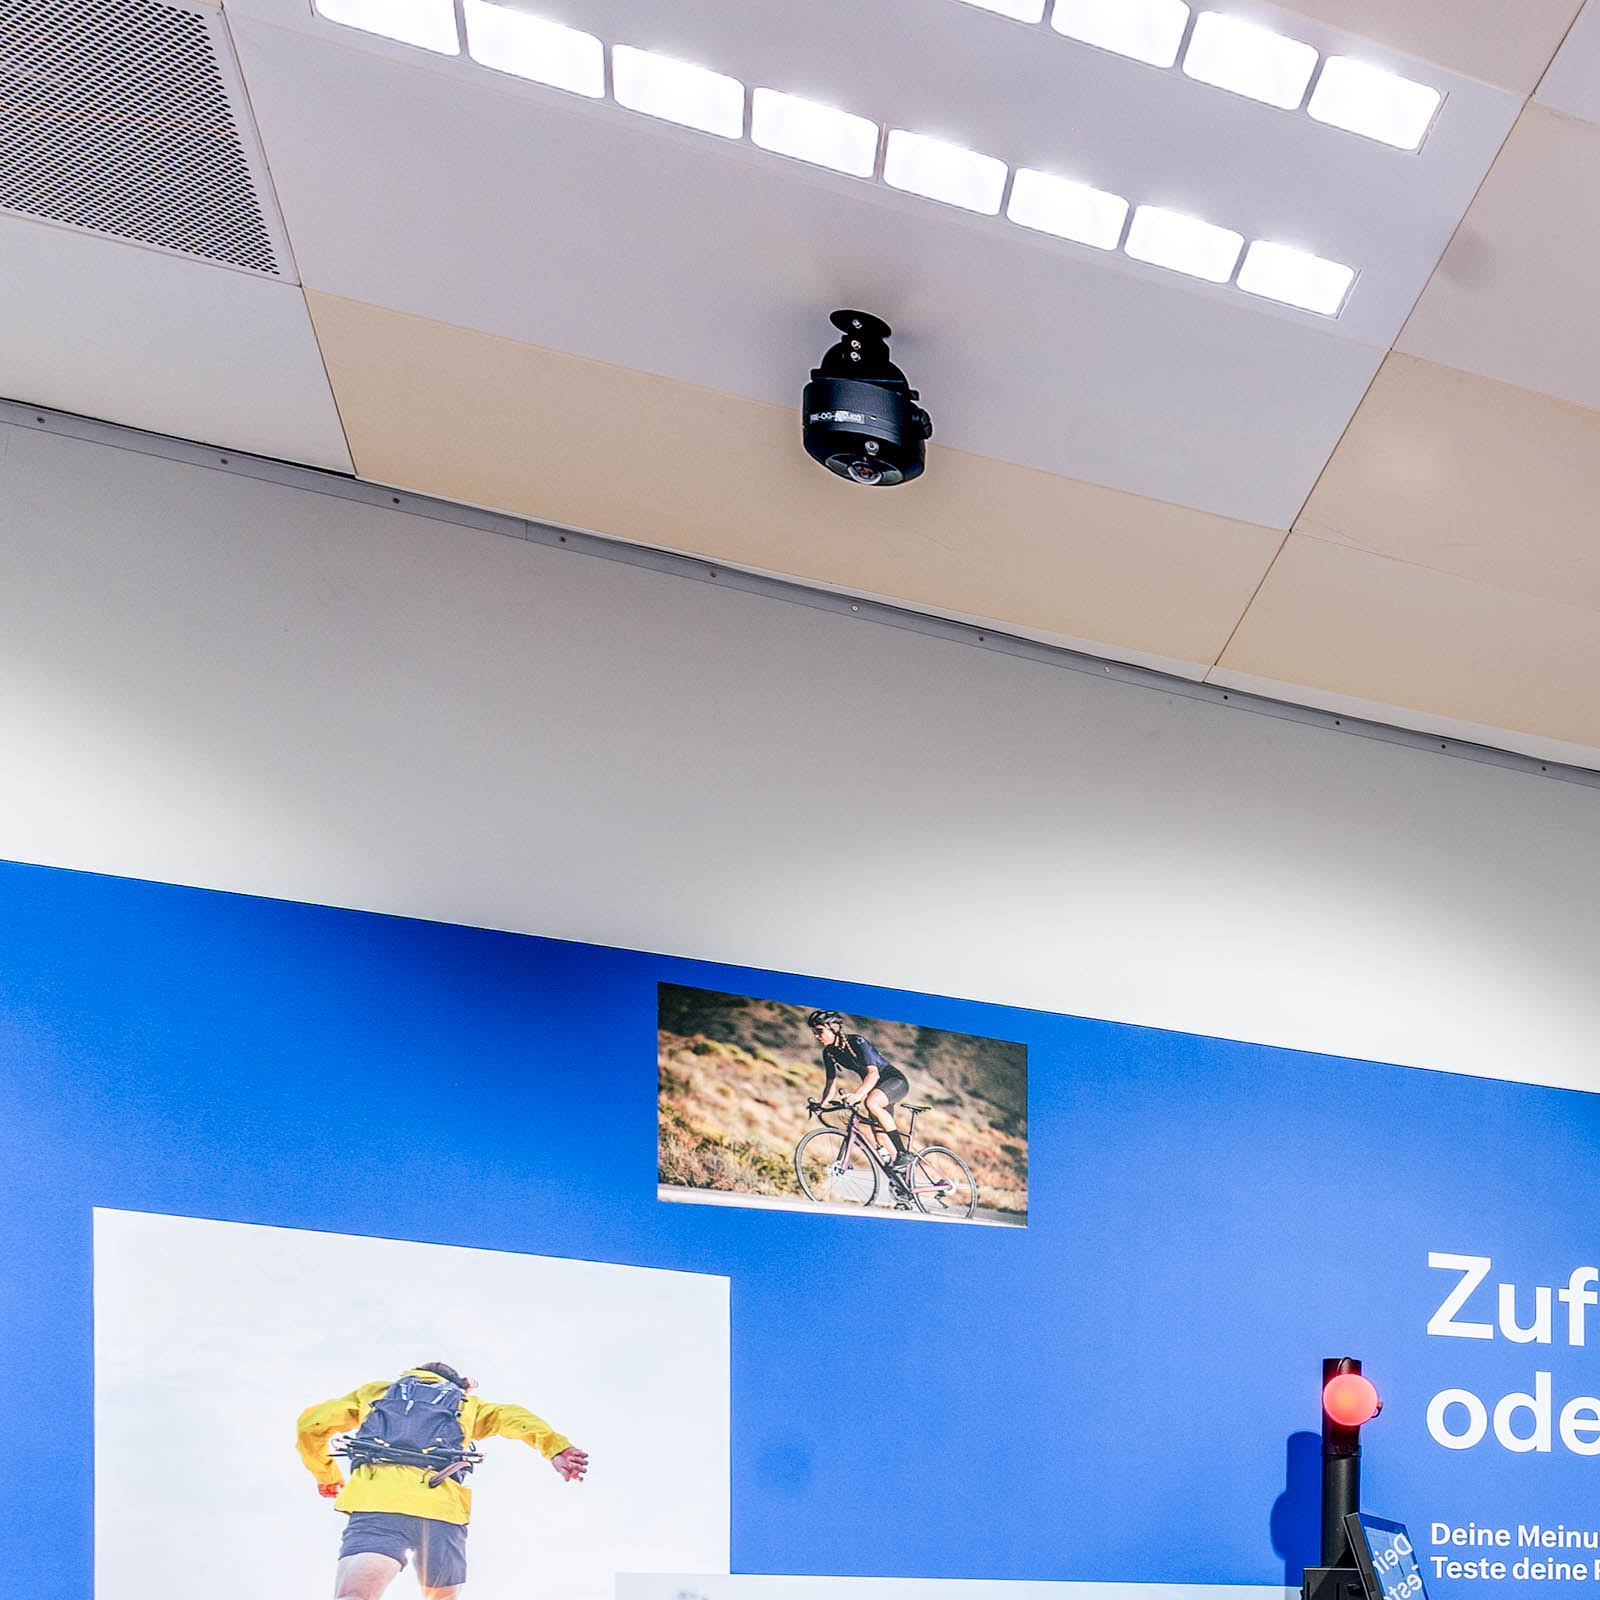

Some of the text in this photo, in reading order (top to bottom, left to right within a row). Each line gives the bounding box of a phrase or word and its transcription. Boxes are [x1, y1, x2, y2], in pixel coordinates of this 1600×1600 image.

[1431, 1522, 1511, 1547] Deine
[1430, 1556, 1507, 1580] Teste
[1512, 1556, 1588, 1581] deine
